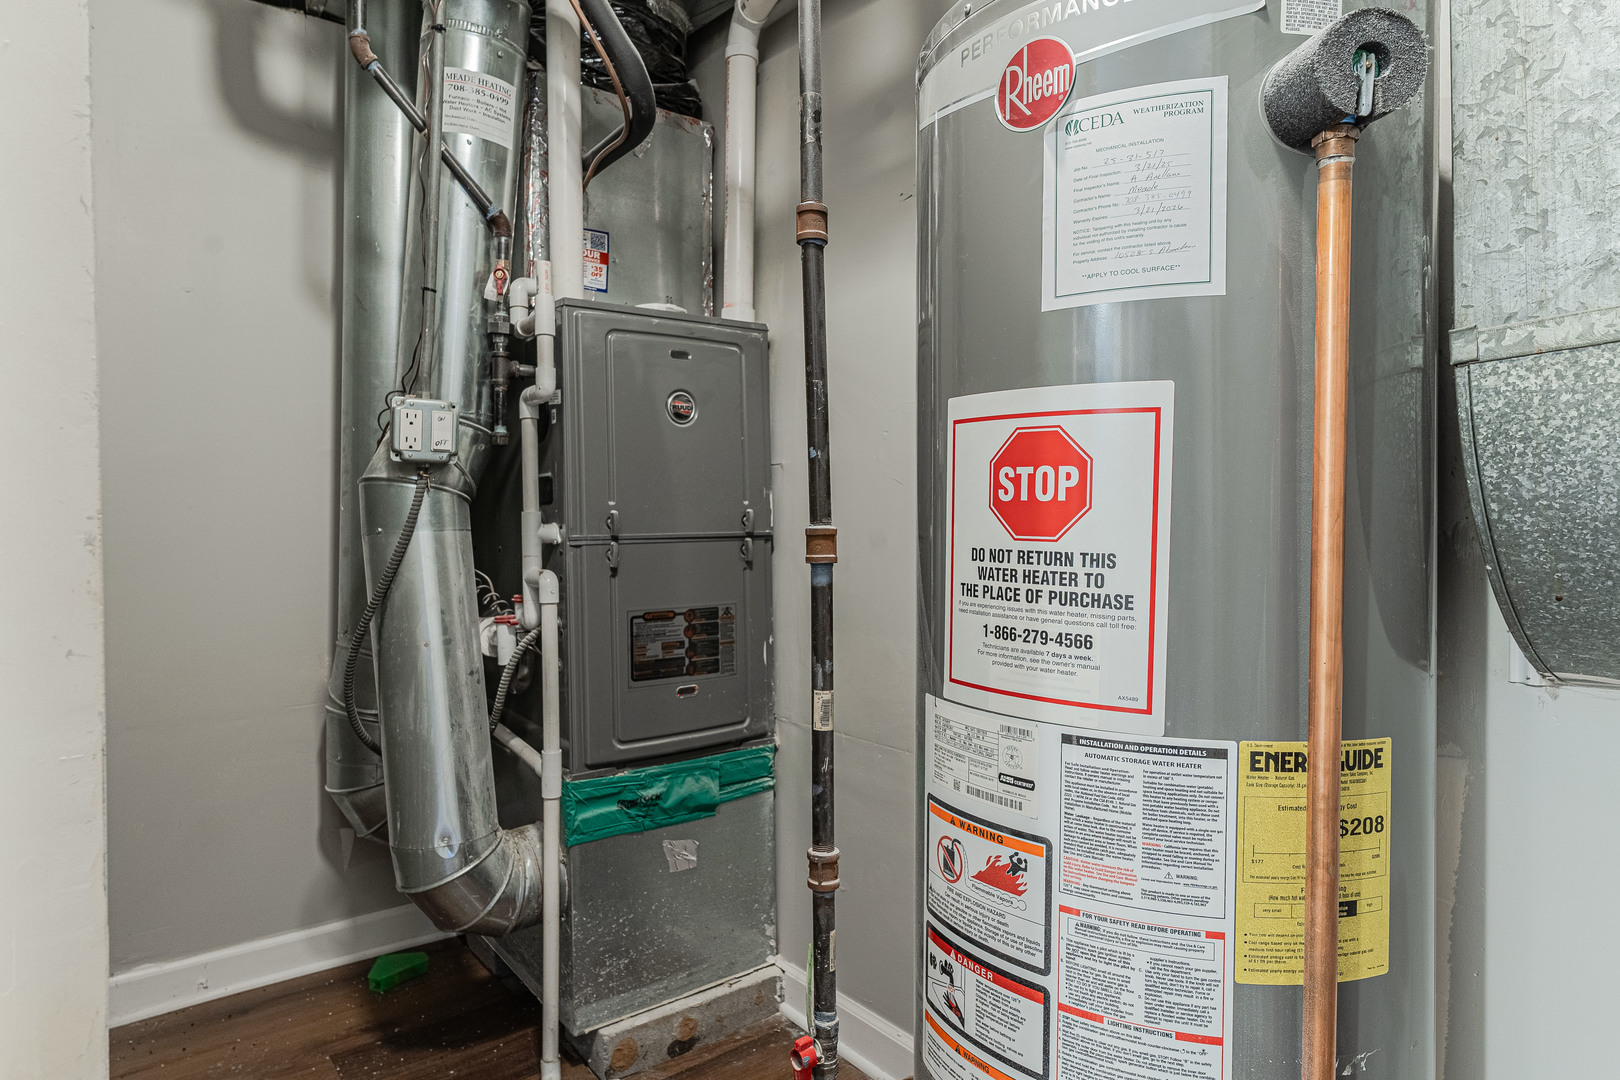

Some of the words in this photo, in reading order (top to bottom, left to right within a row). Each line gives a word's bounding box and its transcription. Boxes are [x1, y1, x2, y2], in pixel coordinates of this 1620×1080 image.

[960, 0, 1135, 67] PERFORMAN
[446, 73, 476, 83] MEADE
[478, 78, 512, 97] HEATING
[1005, 45, 1071, 121] Rheem
[1133, 100, 1204, 114] WEATHERIZATION
[1164, 107, 1204, 117] PROGRAM
[1078, 112, 1124, 132] CEDA
[1096, 143, 1127, 152] MECHANICAL
[1128, 138, 1164, 147] INSTALLATION
[583, 249, 600, 259] OUR
[998, 465, 1079, 502] STOP
[971, 547, 985, 562] DO
[989, 548, 1013, 564] NOT
[1017, 549, 1074, 567] RETURN
[1080, 552, 1117, 569] THIS
[978, 566, 1018, 583] WATER
[1023, 569, 1078, 587] HEATER
[1084, 572, 1105, 589] TO
[960, 582, 979, 598] THE
[983, 585, 1020, 602] PLACE
[1026, 588, 1043, 604] OF
[1048, 590, 1134, 611] PURCHASE
[977, 602, 1006, 611] experiencing
[1067, 611, 1088, 619] heater,
[982, 624, 1094, 650] 1-866-279-4566
[982, 642, 1009, 652] Technicians
[992, 660, 1013, 668] provided
[999, 653, 1028, 662] information,
[1052, 660, 1075, 668] owner's
[1079, 738, 1123, 750] INSTALLATION
[1124, 744, 1138, 752] AND
[1140, 746, 1178, 755] OPERATION
[1179, 749, 1207, 757] DETAILS
[1084, 752, 1120, 763] AUTOMATIC
[1121, 757, 1151, 765] STORAGE
[1014, 780, 1033, 789] CERTIFIED
[960, 822, 1003, 844] WARNING
[972, 884, 995, 898] Flammable
[996, 894, 1013, 905] Vapors
[962, 892, 986, 910] EXPLOSION
[987, 906, 1006, 919] HAZARD
[1094, 914, 1108, 923] YOUR
[1109, 918, 1129, 927] SAFETY
[1130, 922, 1145, 930] READ
[1147, 924, 1168, 934] BEFORE
[1170, 928, 1202, 938] OPERATING
[958, 956, 993, 981] DANGER
[1108, 1020, 1132, 1031] LIGHTING
[1133, 1026, 1173, 1038] INSTRUCTIONS
[963, 1052, 990, 1073] WARNING
